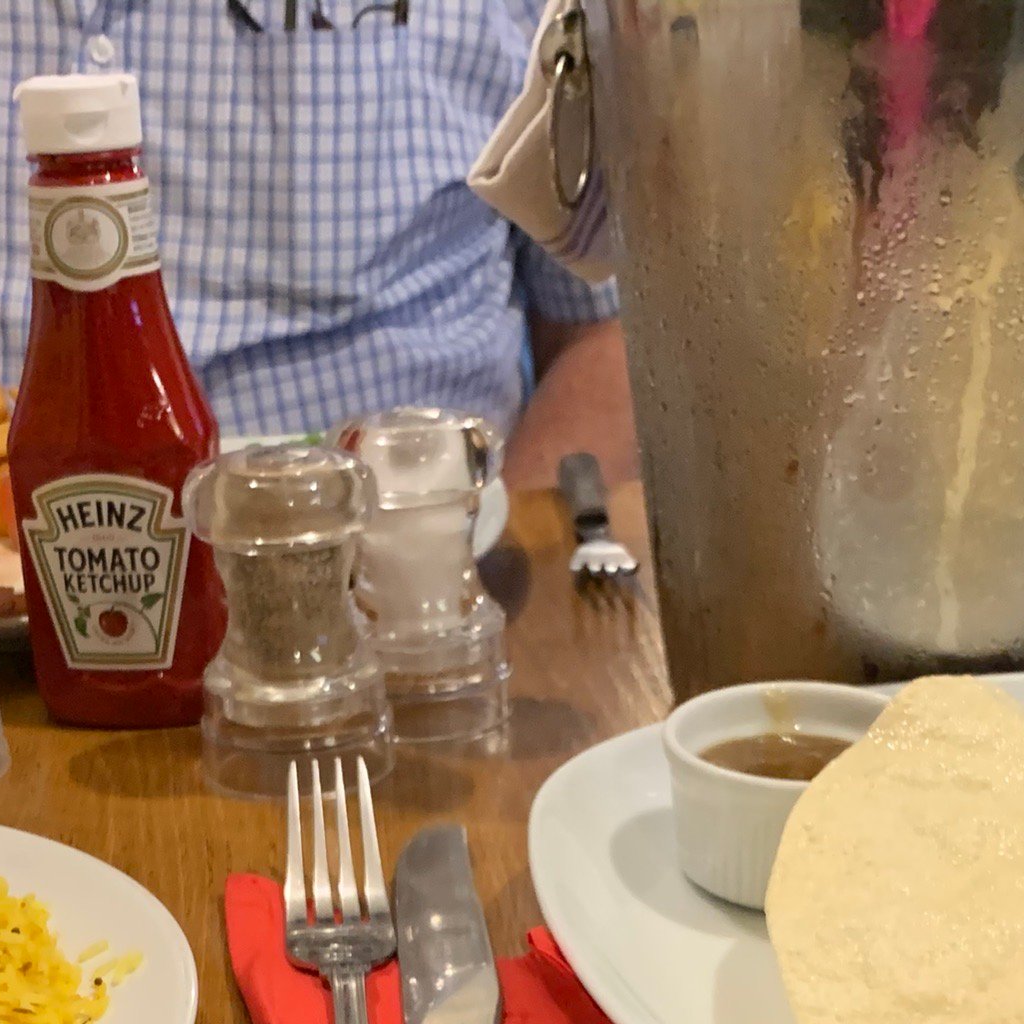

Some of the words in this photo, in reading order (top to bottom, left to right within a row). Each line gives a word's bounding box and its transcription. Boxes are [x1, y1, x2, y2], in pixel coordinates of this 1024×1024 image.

[56, 500, 146, 533] HEINZ
[53, 547, 160, 573] TOMATO
[64, 573, 156, 594] KETCHUP
